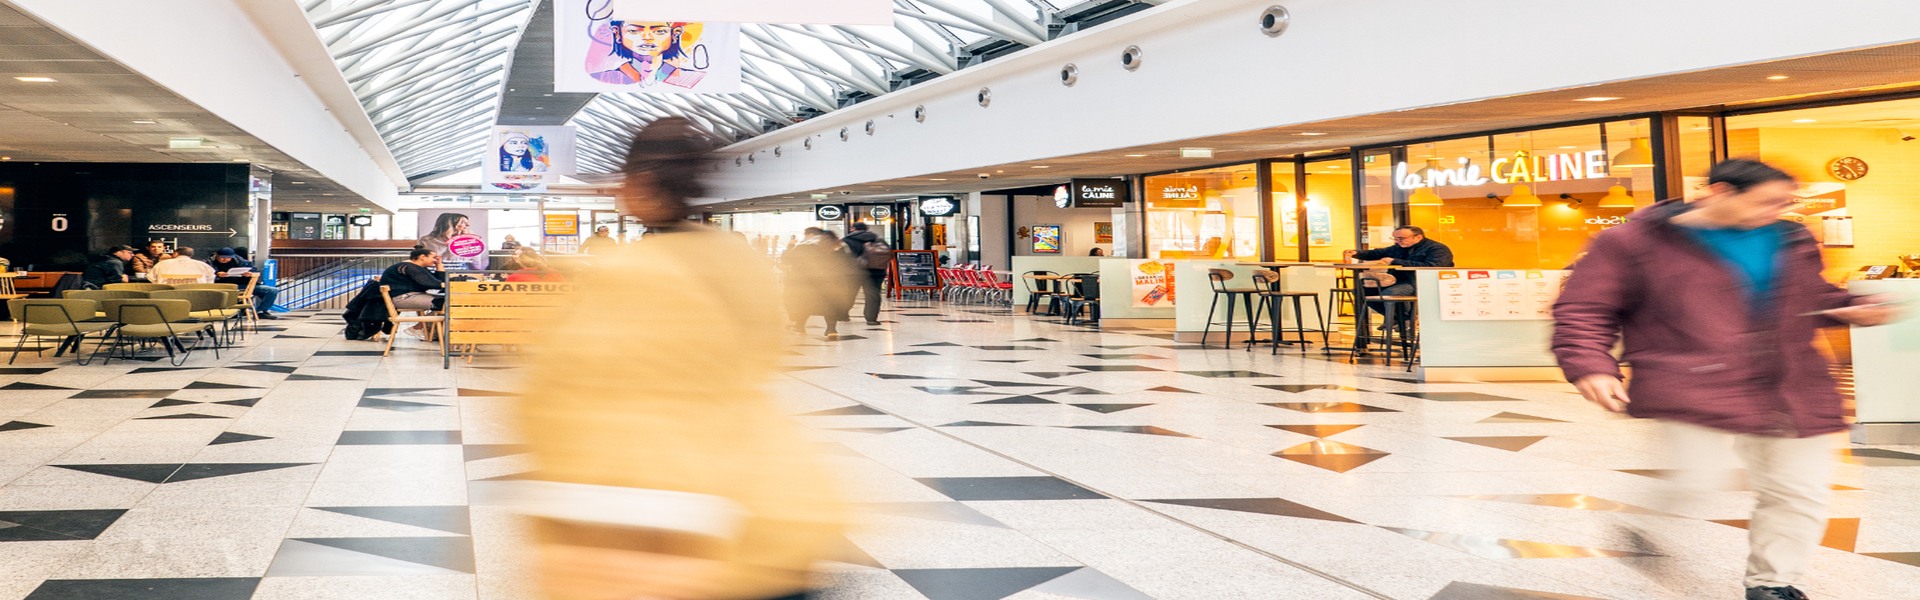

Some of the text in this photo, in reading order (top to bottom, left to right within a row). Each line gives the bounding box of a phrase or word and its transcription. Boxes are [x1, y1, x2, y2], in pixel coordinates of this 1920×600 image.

[1396, 150, 1607, 189] la mie CÂLINE
[1082, 191, 1115, 199] CÂLINE
[1135, 278, 1165, 286] MALIN
[477, 283, 577, 292] STARBUC
